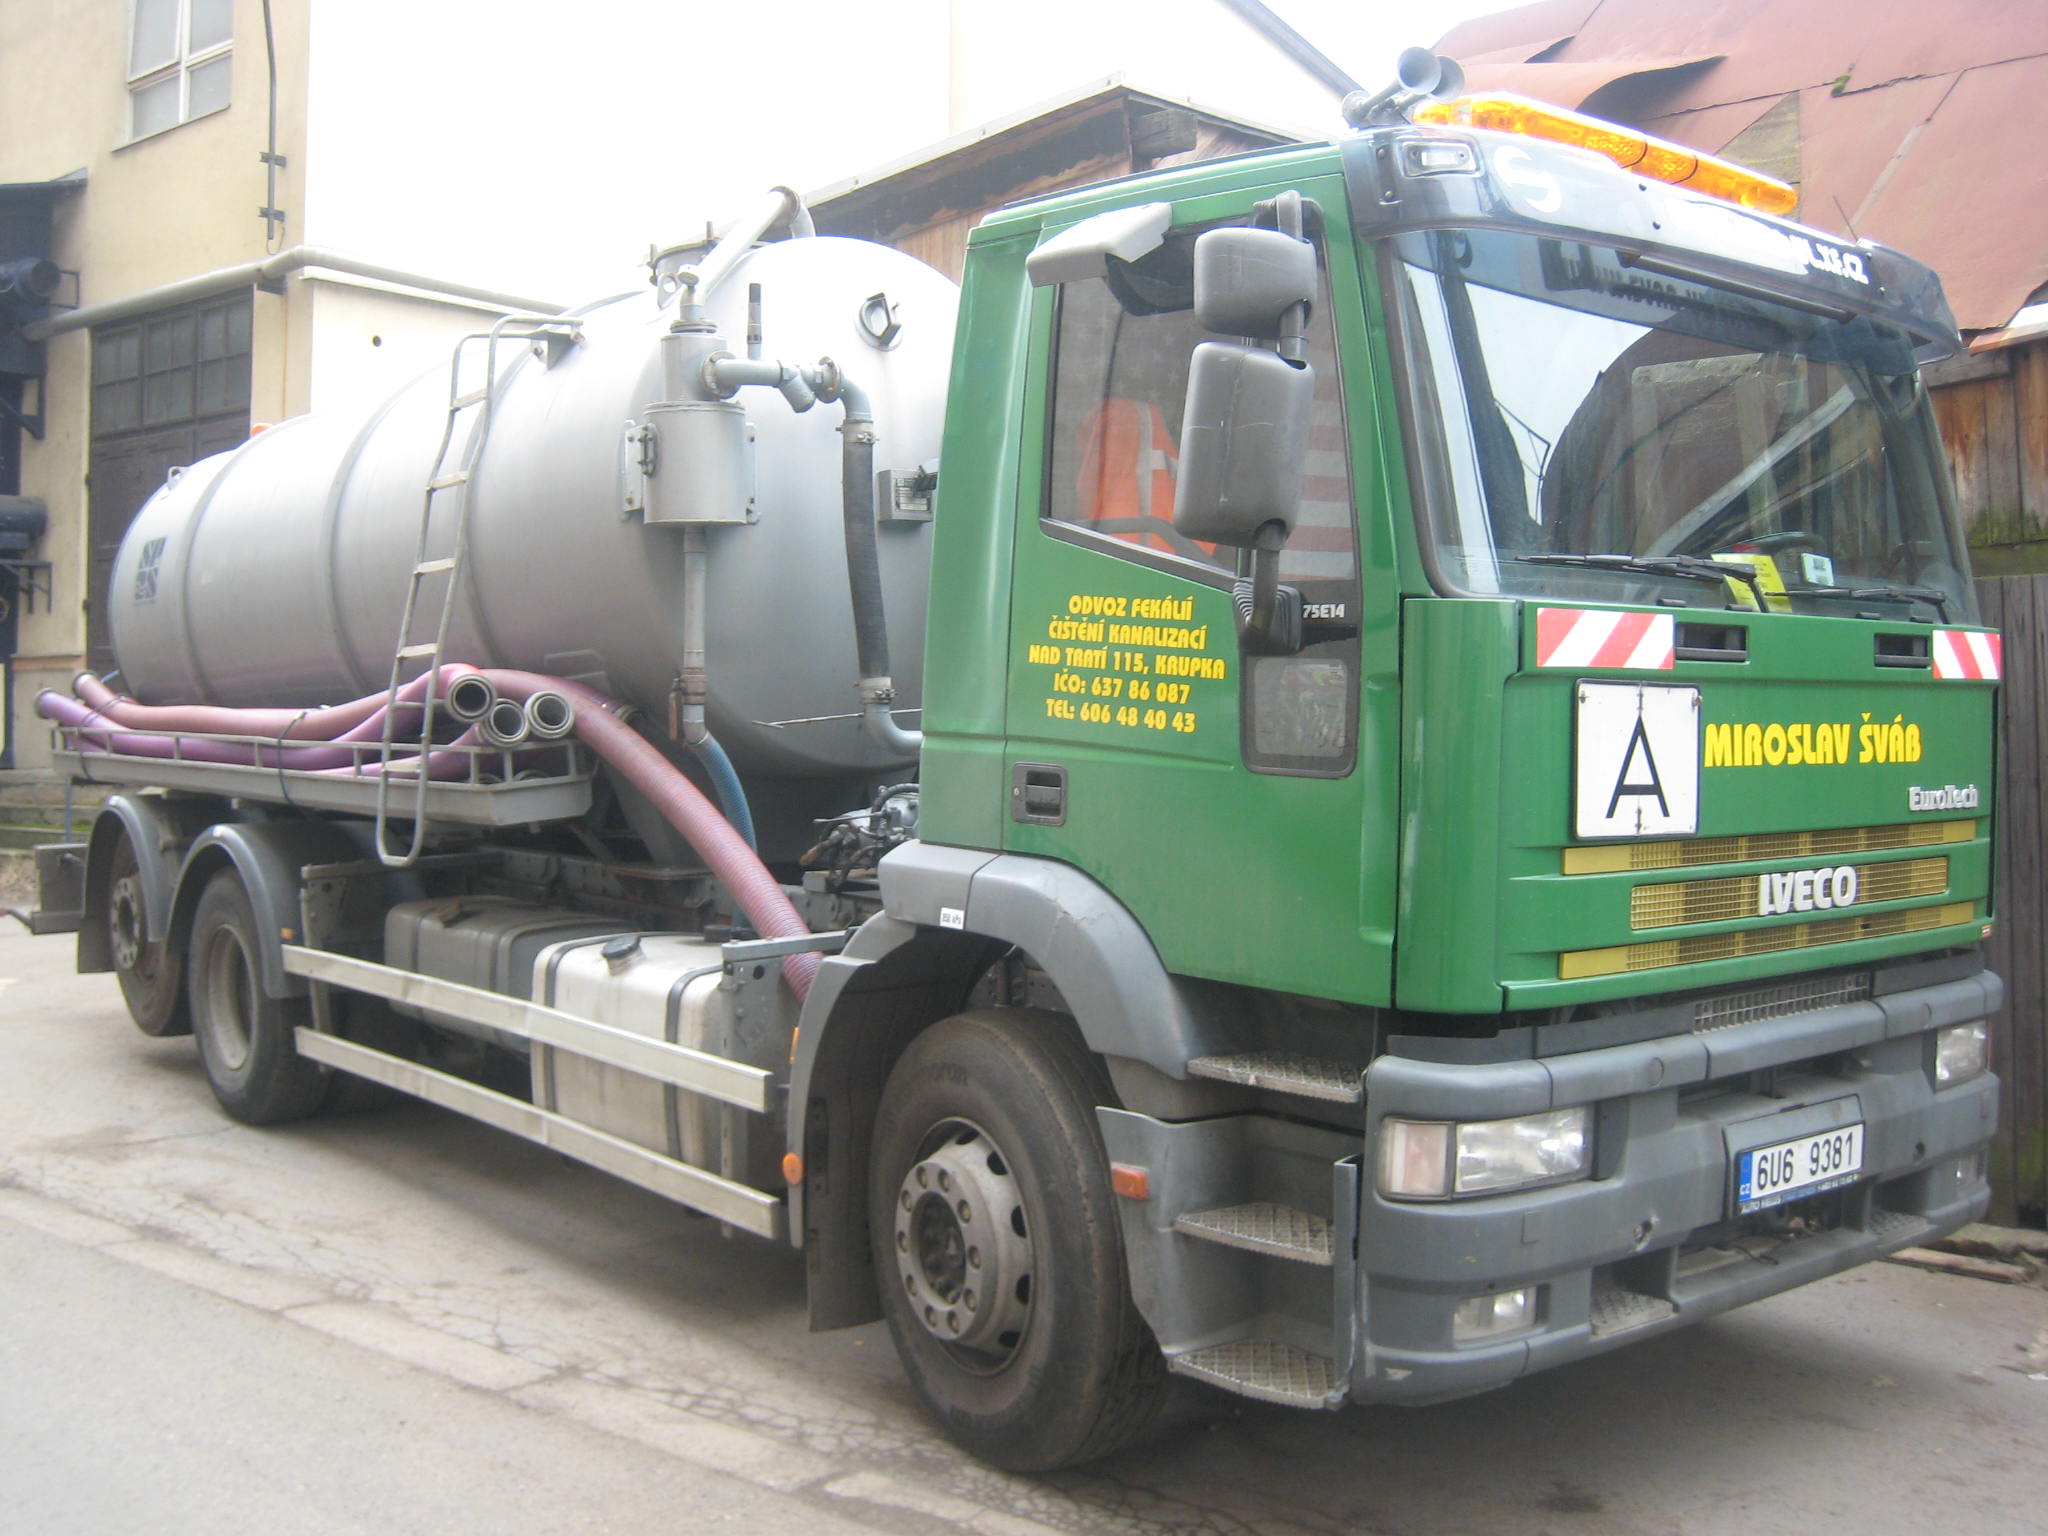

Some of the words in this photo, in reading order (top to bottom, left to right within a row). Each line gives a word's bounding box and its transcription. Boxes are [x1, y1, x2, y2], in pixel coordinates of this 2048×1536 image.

[1068, 595, 1128, 617] ODVOZ
[1302, 603, 1345, 619] 75E14
[1048, 614, 1106, 643] ČIŠTĚNÍ
[1108, 624, 1208, 650] KANALIZACÍ
[1028, 644, 1061, 665] NAD
[1065, 646, 1108, 670] TRATÍ
[1112, 651, 1149, 675] 115,
[1155, 654, 1226, 680] KRUPKA
[1053, 668, 1087, 694] IČO:
[1091, 676, 1123, 698] 637
[1128, 679, 1151, 701] 86
[1156, 683, 1191, 705] 087
[1046, 698, 1075, 720] TEL:
[1079, 702, 1112, 724] 606
[1115, 705, 1138, 727] 48
[1143, 709, 1167, 731] 40
[1171, 712, 1196, 733] 43
[1704, 723, 1851, 768] MIROSLAV
[1859, 712, 1923, 764] ŠVÁB
[1605, 713, 1670, 819] A
[1909, 784, 1978, 811] EuroTech
[1760, 866, 1857, 916] IVECO
[1757, 1148, 1794, 1190] 6U6
[1809, 1131, 1853, 1177] 9381
[1739, 1183, 1751, 1196] CZ
